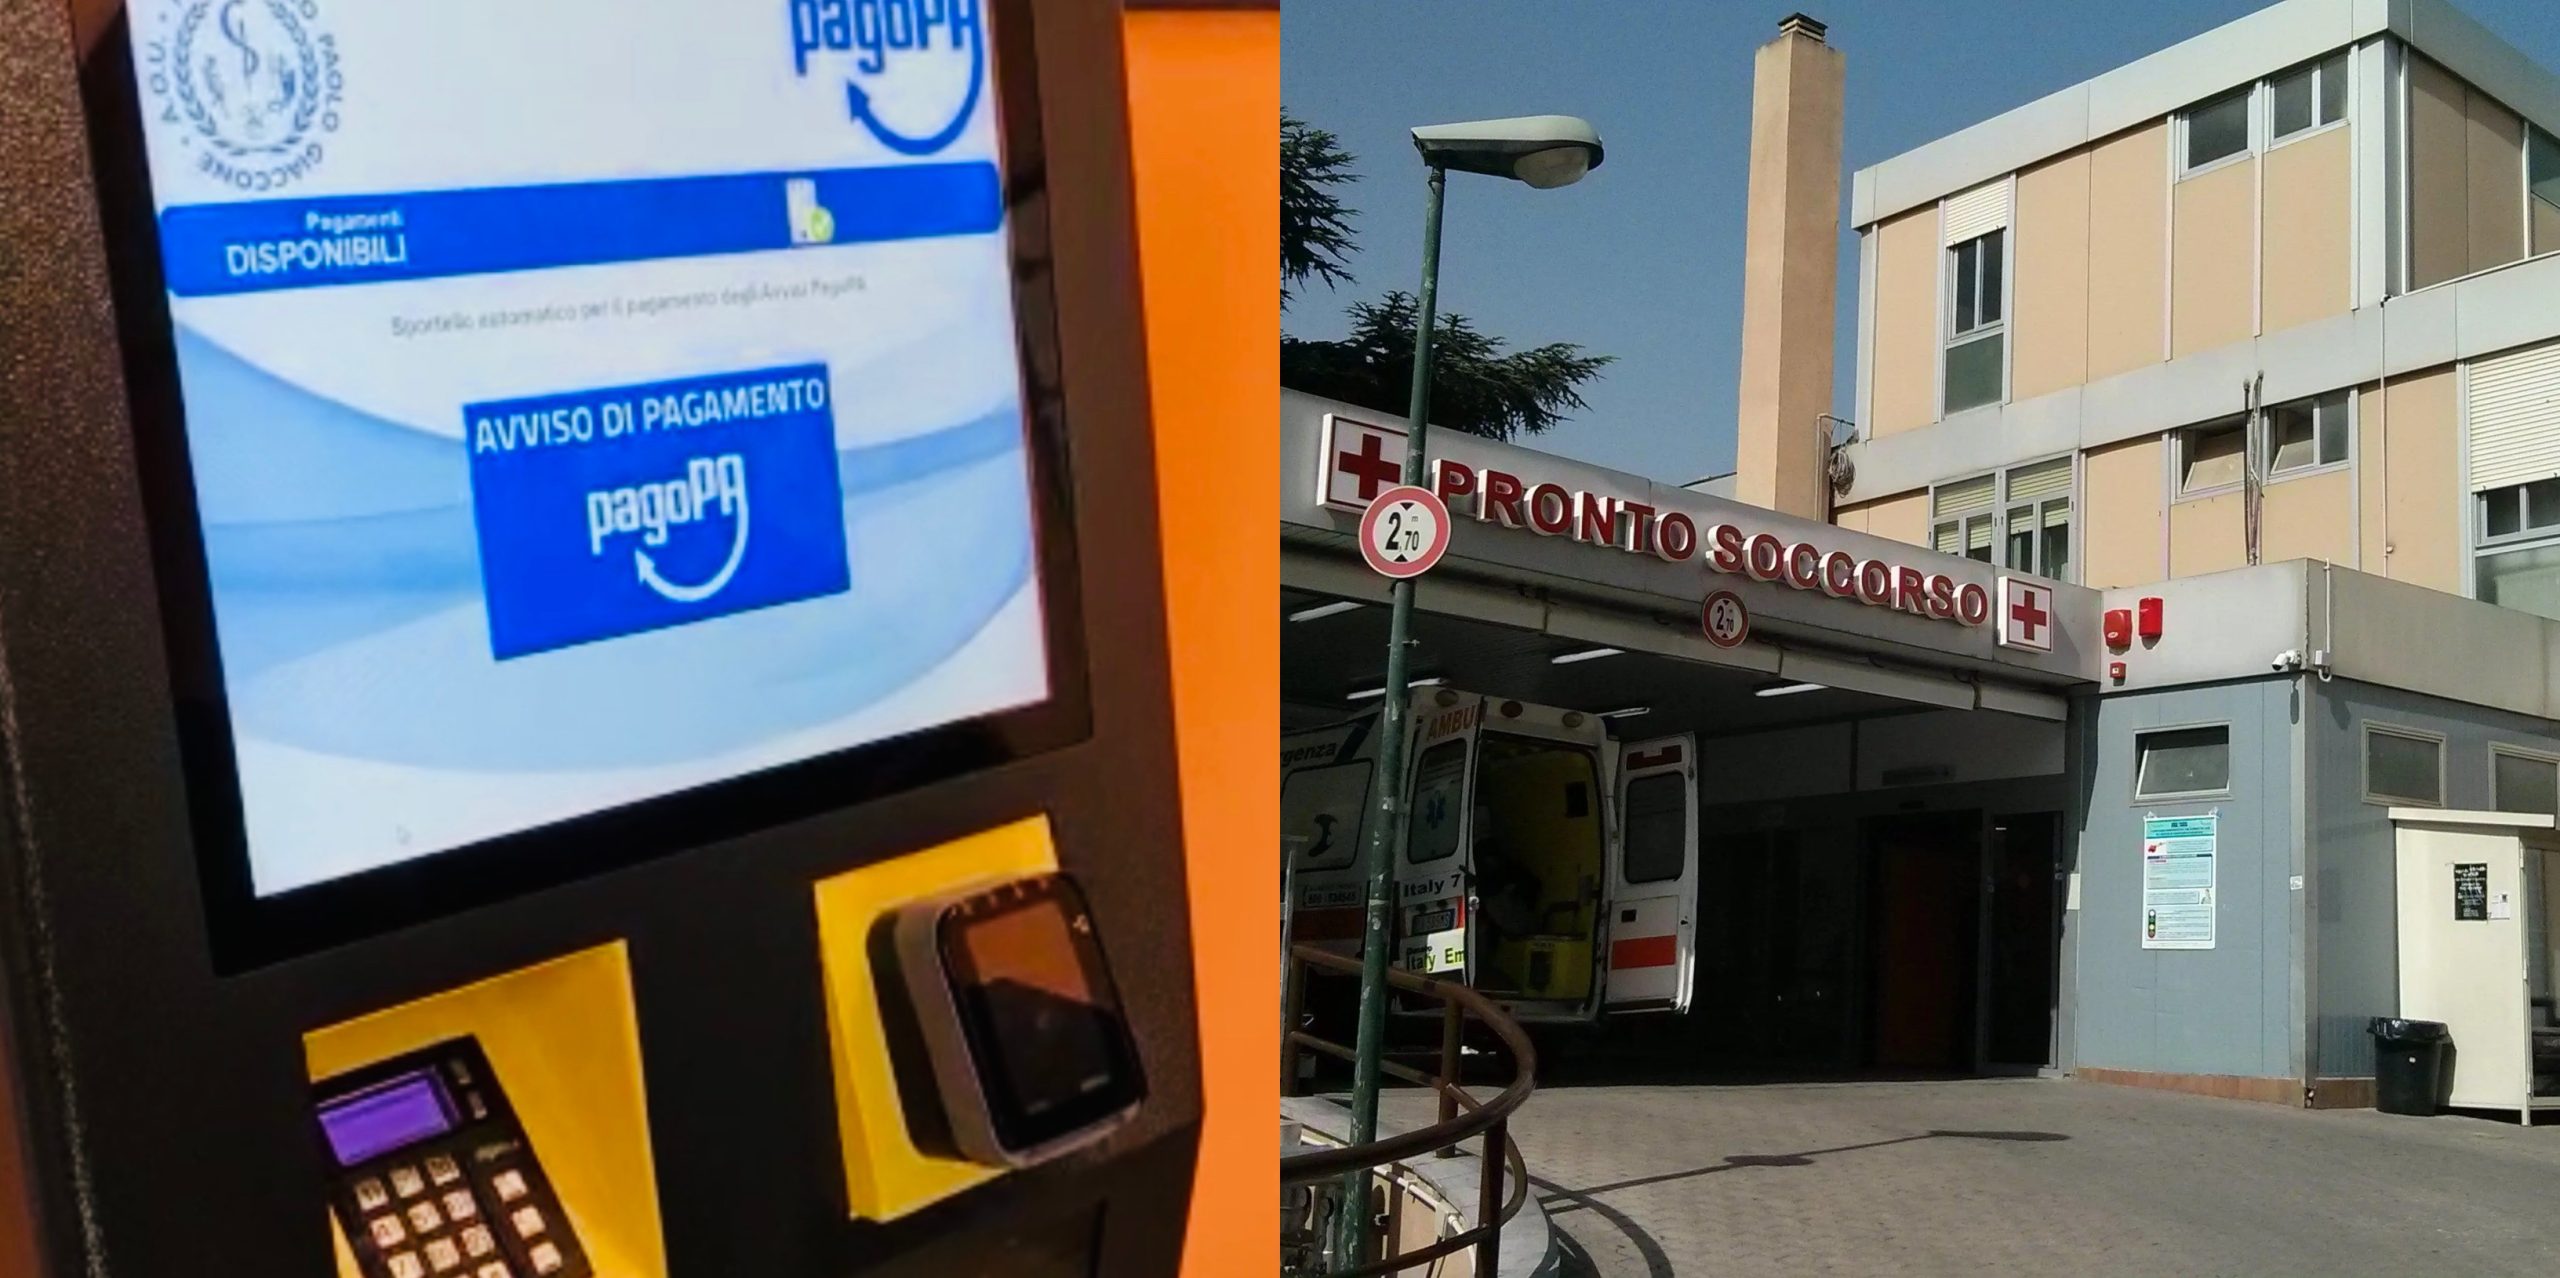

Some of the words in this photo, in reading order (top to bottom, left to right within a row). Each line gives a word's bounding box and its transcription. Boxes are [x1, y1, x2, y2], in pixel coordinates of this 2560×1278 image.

[788, 0, 980, 77] pagoPA
[318, 33, 344, 133] PAOLO
[199, 143, 323, 191] GIACCONE
[226, 233, 407, 276] DISPONIBILI
[475, 405, 594, 455] AVVISO
[602, 402, 635, 439] DI
[642, 377, 826, 432] PAGAMENTO
[587, 453, 747, 556] pagoPA
[1431, 458, 1697, 563] PRONTO
[1705, 523, 1989, 628] SOCCORSO
[1404, 879, 1445, 898] Italy
[1451, 873, 1461, 888] 7
[1406, 953, 1436, 971] Italy
